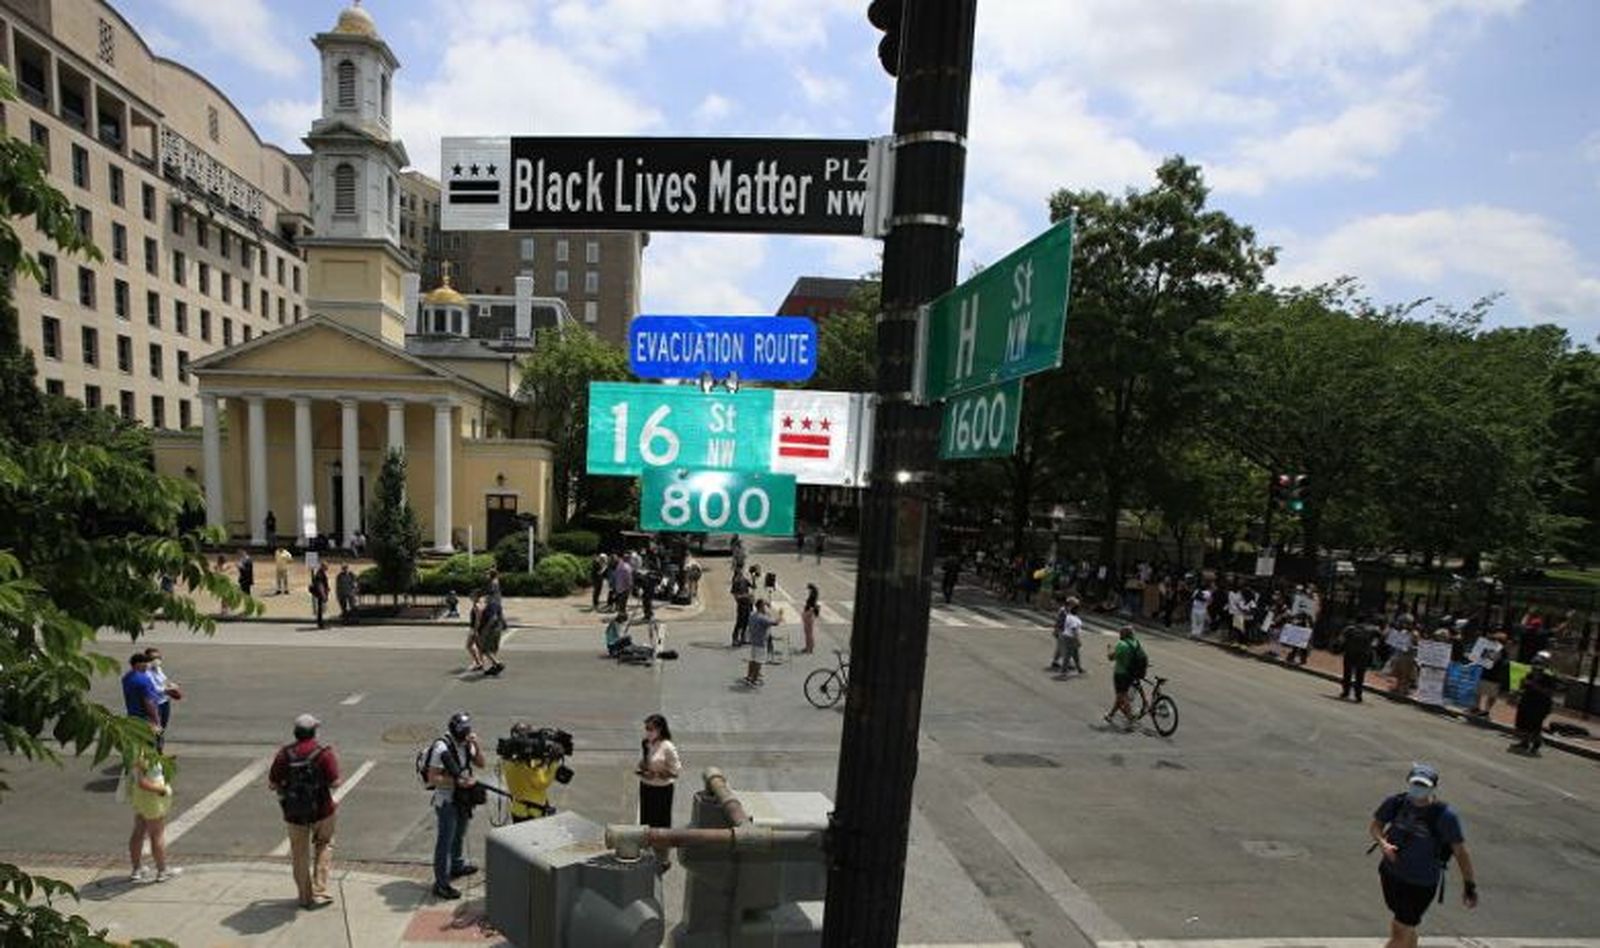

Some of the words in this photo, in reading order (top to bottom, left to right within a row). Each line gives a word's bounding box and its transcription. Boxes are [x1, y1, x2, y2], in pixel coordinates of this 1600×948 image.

[514, 158, 603, 213] Black
[615, 158, 697, 214] Lives
[708, 159, 812, 215] Matter
[825, 158, 868, 181] PLZ
[827, 190, 866, 216] NW
[1011, 258, 1034, 311] St
[637, 332, 744, 363] EVACUATION
[754, 333, 809, 364] ROUTE
[955, 293, 979, 380] H
[1004, 312, 1031, 363] NW
[611, 402, 680, 466] 16
[708, 402, 736, 433] St
[949, 392, 1006, 452] 1600
[707, 439, 736, 467] NW
[660, 484, 770, 529] 800
